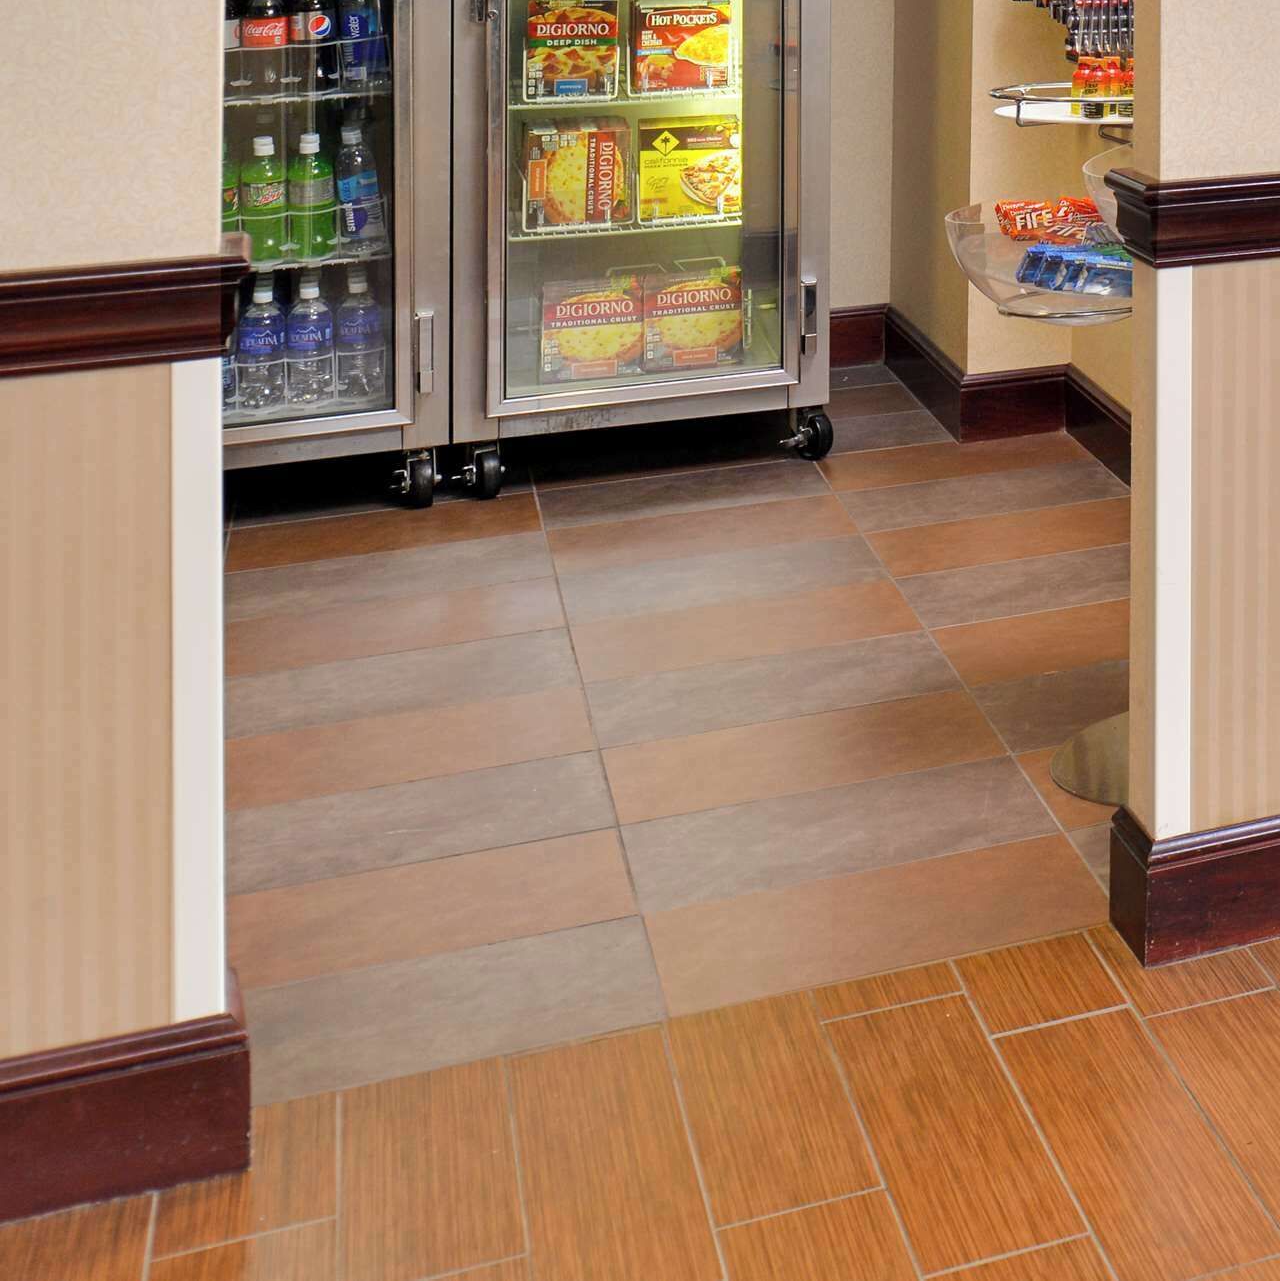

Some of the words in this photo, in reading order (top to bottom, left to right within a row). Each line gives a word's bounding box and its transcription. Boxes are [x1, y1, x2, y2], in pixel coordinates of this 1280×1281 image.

[651, 14, 673, 27] HOT
[673, 12, 718, 26] POCKETS
[546, 39, 573, 47] DEEP
[574, 38, 598, 46] DISH
[652, 304, 708, 316] TRADITIONAL
[709, 302, 735, 311] CRUST
[551, 318, 609, 328] TRADITIONAL
[610, 315, 638, 323] CRUST
